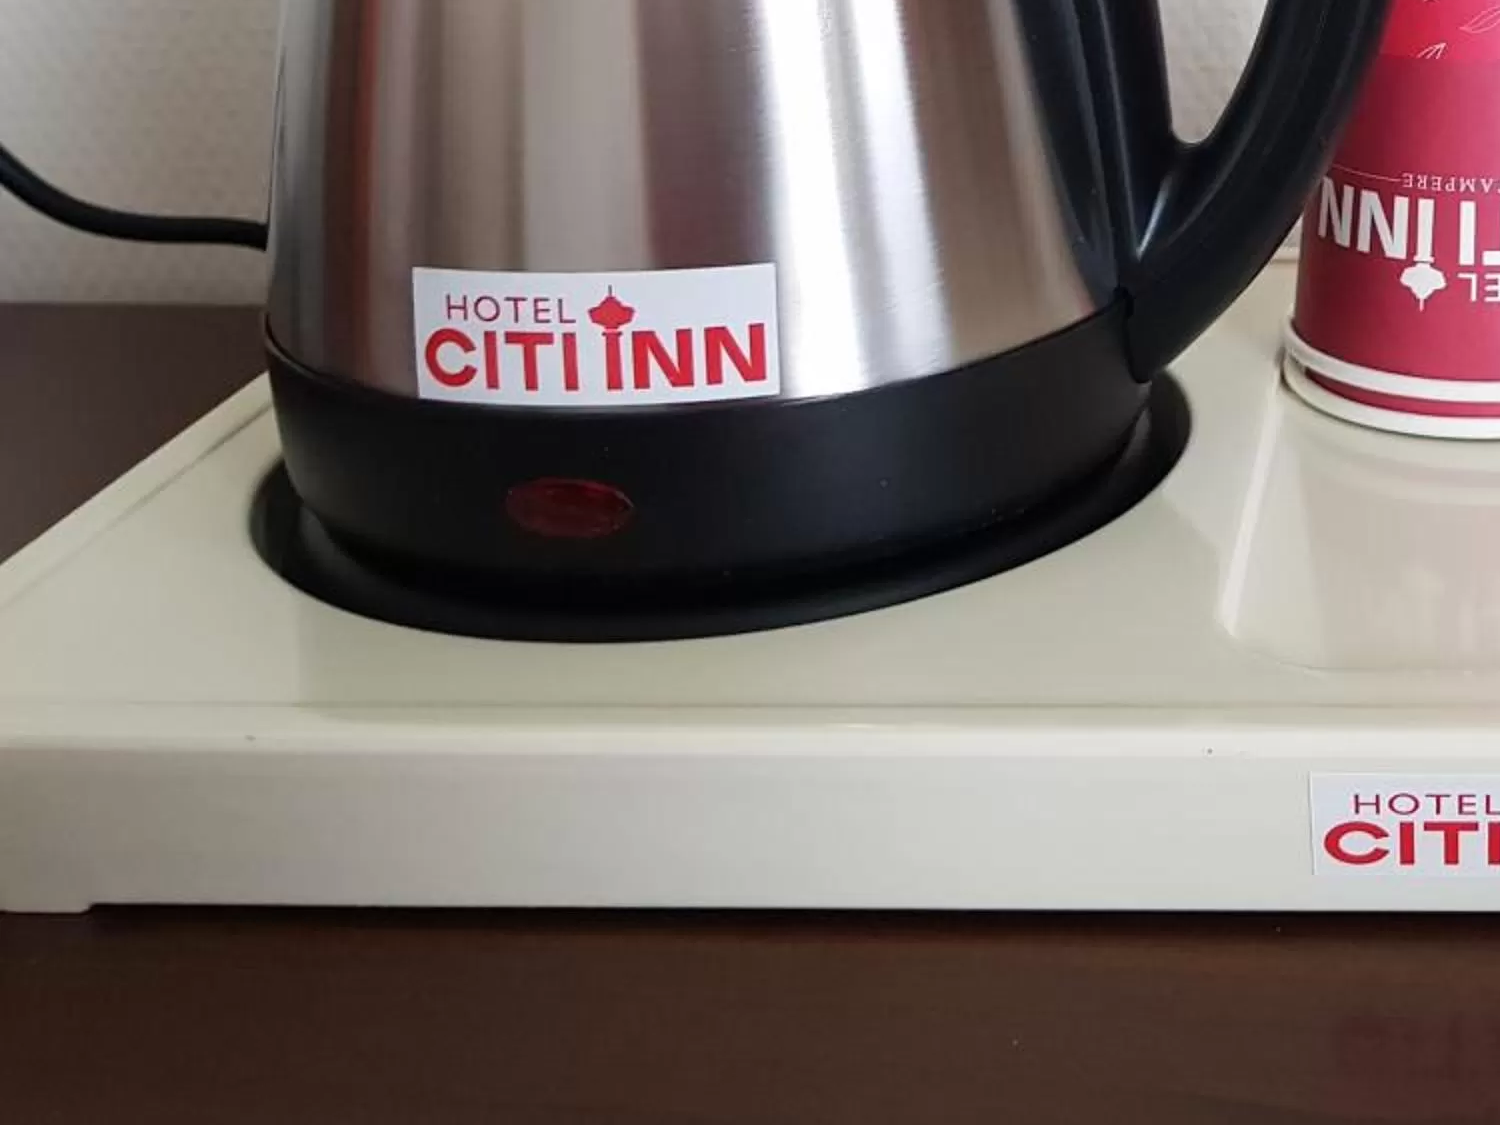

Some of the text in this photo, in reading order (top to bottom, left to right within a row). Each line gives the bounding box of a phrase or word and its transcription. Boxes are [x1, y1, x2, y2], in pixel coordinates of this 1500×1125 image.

[1317, 175, 1436, 262] INN
[446, 293, 577, 324] HOTEL
[424, 322, 767, 392] CITI INN
